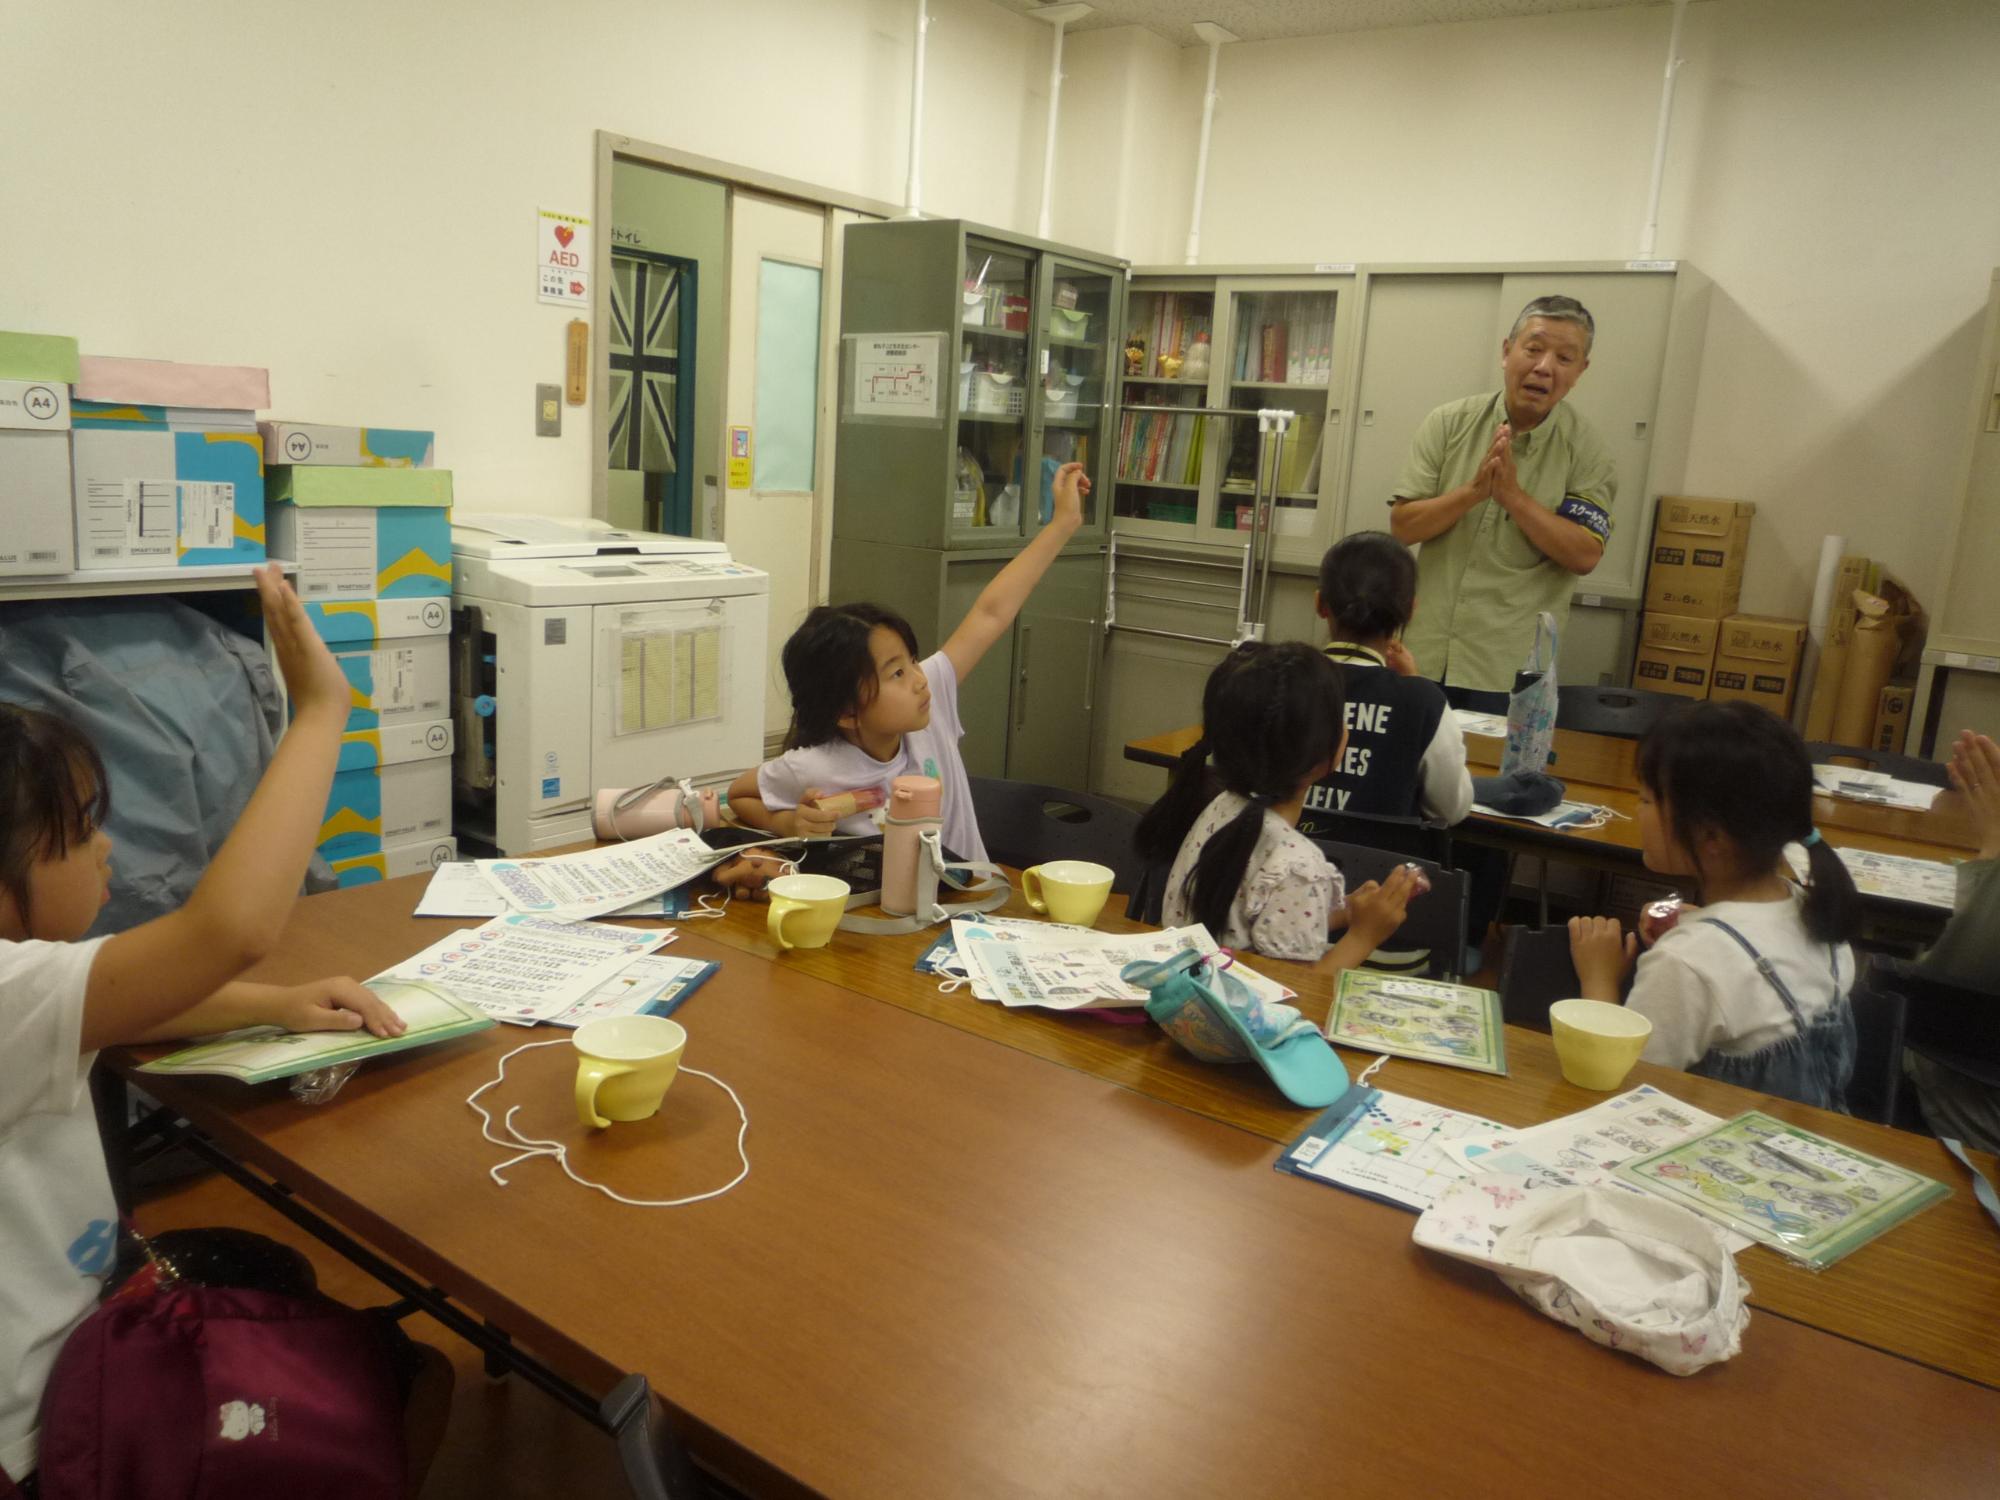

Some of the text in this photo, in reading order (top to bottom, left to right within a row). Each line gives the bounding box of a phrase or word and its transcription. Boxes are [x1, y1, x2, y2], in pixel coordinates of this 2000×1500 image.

[549, 250, 579, 267] AED
[32, 397, 51, 409] A4
[427, 611, 440, 621] A4
[431, 734, 443, 742] A4
